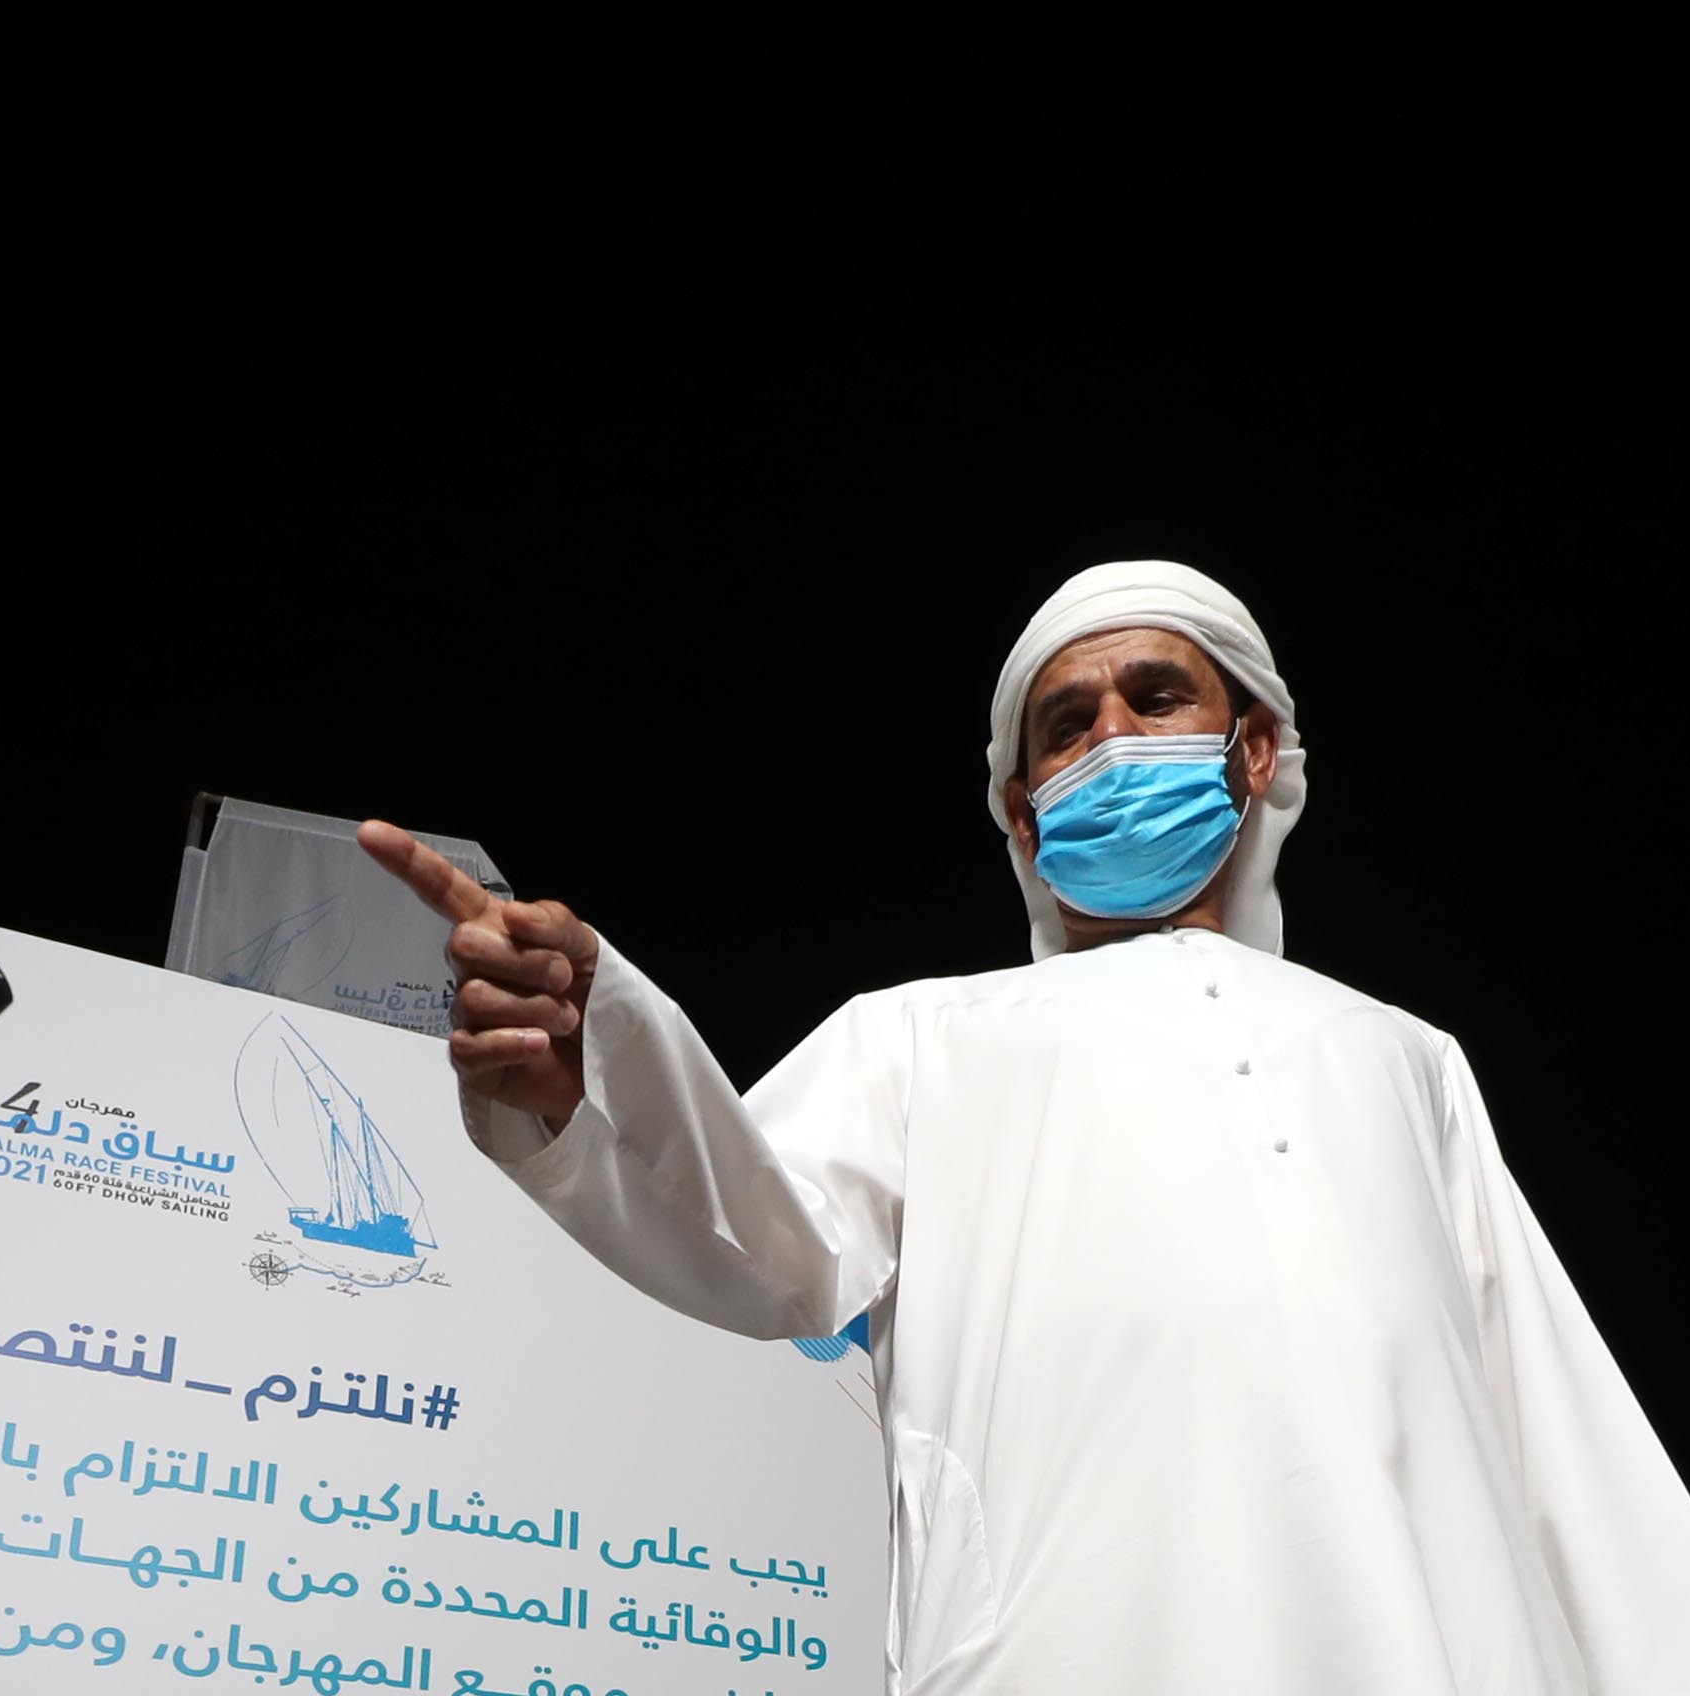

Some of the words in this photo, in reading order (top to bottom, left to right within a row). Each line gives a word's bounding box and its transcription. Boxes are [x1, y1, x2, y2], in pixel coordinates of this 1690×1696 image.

[0, 1081, 42, 1134] 4
[65, 1097, 136, 1119] مهرجان
[102, 1121, 236, 1174] سباق
[63, 1151, 122, 1176] RACE
[129, 1165, 232, 1198] FESTIVAL
[52, 1178, 96, 1195] 60FT
[101, 1188, 156, 1208] DHOW
[160, 1199, 230, 1223] SAILING
[63, 1439, 279, 1506] الالتزام
[299, 1480, 580, 1551] المشاركين
[599, 1526, 710, 1571] على
[266, 1555, 360, 1602] من
[381, 1563, 589, 1630] المحددة
[728, 1553, 829, 1600] يجب
[608, 1595, 829, 1671] والوقائية
